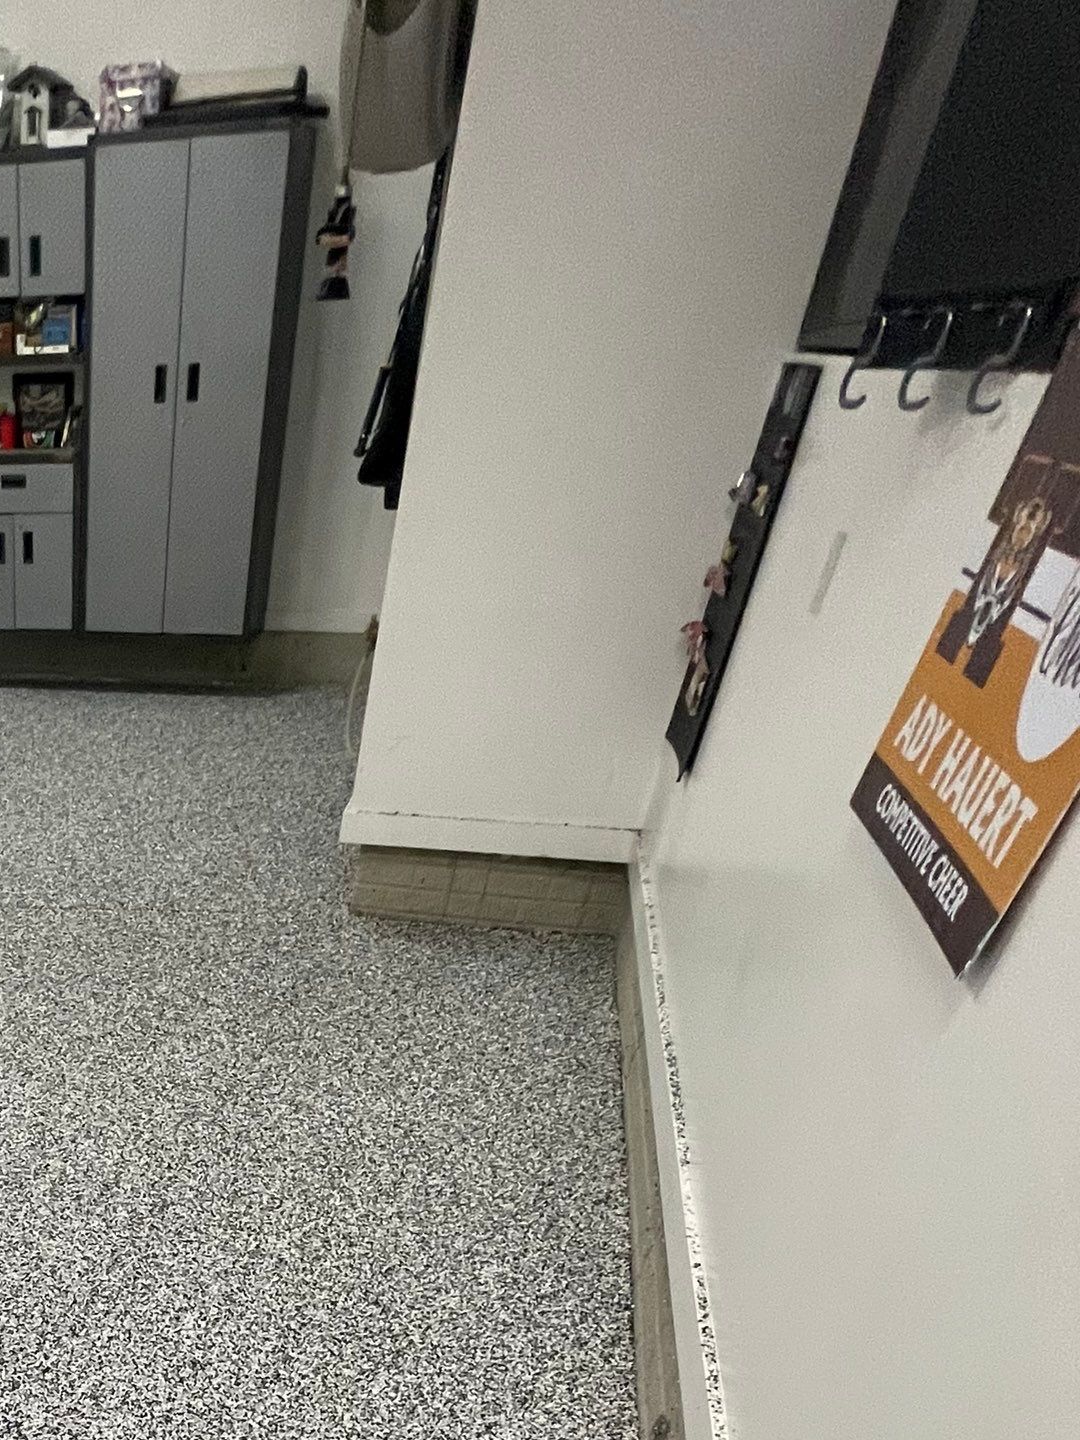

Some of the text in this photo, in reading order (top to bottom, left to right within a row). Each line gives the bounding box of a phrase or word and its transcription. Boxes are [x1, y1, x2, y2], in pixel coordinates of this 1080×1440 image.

[875, 783, 969, 922] COMPETITIVE CHEER
[894, 693, 1039, 868] ADY HAUERT
